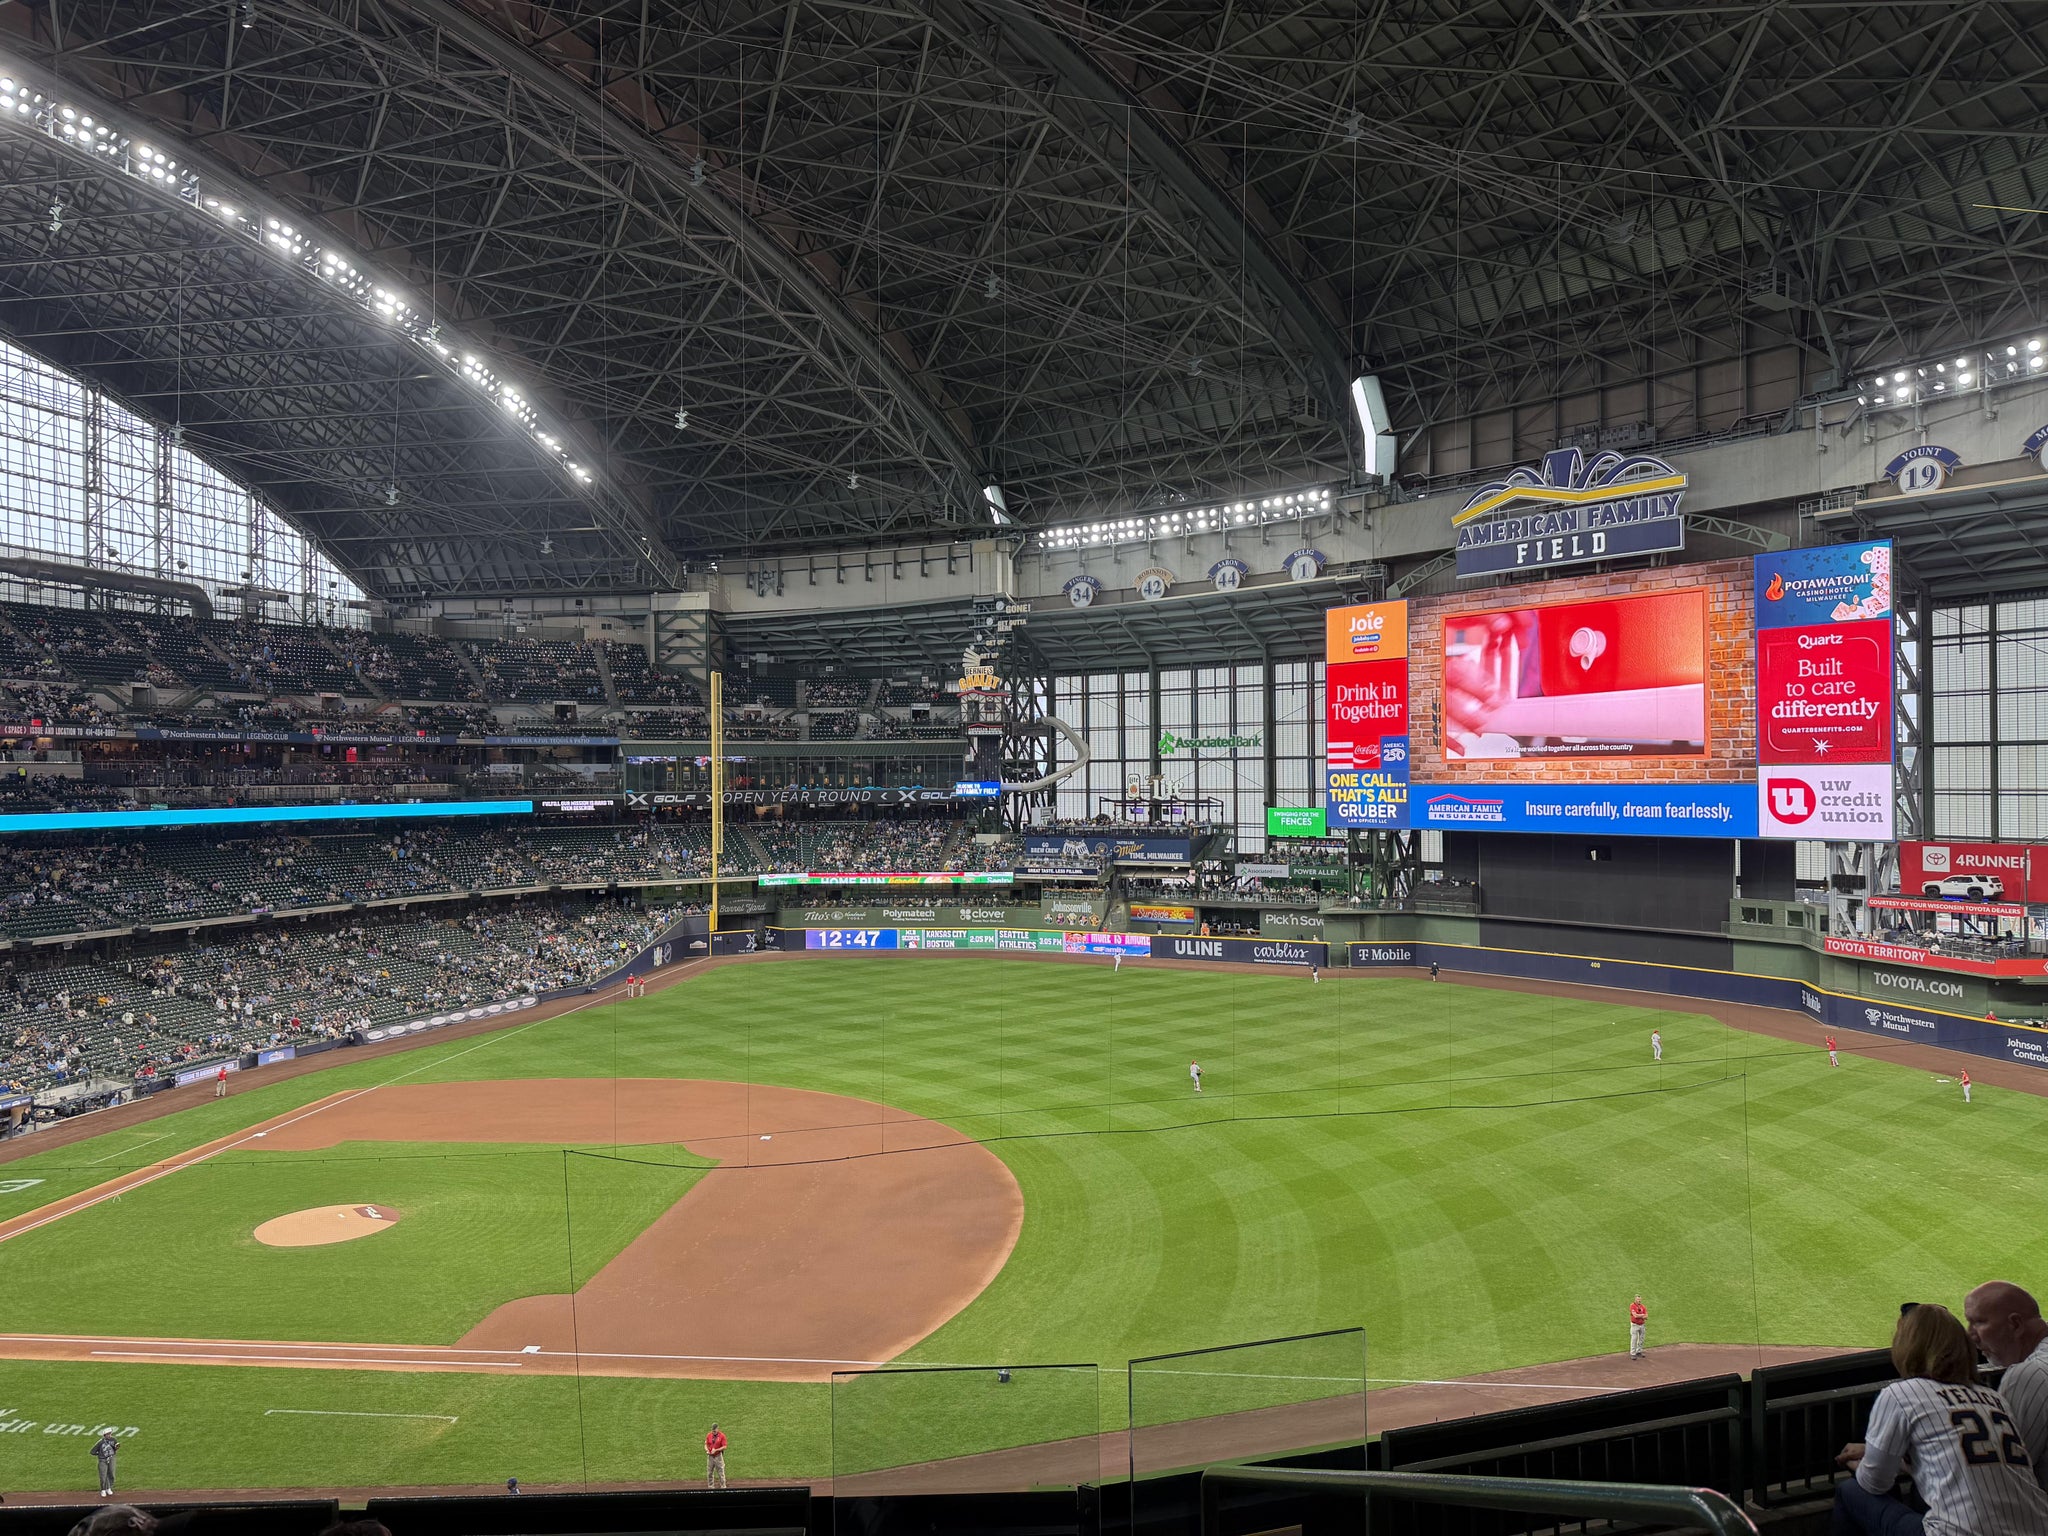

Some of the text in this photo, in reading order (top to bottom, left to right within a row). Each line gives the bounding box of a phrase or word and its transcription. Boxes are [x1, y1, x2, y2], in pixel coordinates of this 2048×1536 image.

[1901, 447, 1942, 462] YOUNT
[1905, 464, 1938, 491] 19
[1457, 490, 1687, 549] AMERICAN FAMILY
[1293, 548, 1315, 559] SELIG
[1516, 532, 1606, 564] FIELD
[1217, 560, 1239, 570] AARON
[1300, 562, 1309, 579] 1
[1138, 567, 1169, 580] ROBINSON
[1218, 571, 1237, 587] 44
[1068, 576, 1096, 586] FINGERS
[1143, 580, 1162, 596] 42
[1784, 574, 1870, 591] POTAWATOMI
[1072, 587, 1091, 602] 34
[1796, 586, 1854, 598] CASINO HOTEL
[1806, 594, 1847, 602] MILWAUKEE
[1005, 604, 1031, 614] GONE!
[1348, 610, 1384, 633] Joie
[1798, 634, 1844, 650] Quartz
[965, 667, 994, 676] BERNIE'S
[1798, 658, 1844, 678] Built
[959, 674, 1000, 690] CHALET
[1786, 680, 1856, 697] to care
[1336, 681, 1397, 703] Drink in
[1332, 700, 1403, 723] Together
[1771, 697, 1880, 720] differently
[169, 730, 289, 741] Northwestern Mutual LEGENDS CLUB
[1781, 725, 1863, 734] QUARTZBENEFITS.COM
[323, 734, 369, 742] Northwestern
[398, 735, 425, 743] LEGENDS
[1175, 735, 1262, 748] Associated Bank
[1383, 748, 1406, 762] 250
[1548, 745, 1572, 753] together
[1610, 744, 1633, 752] country
[1329, 773, 1406, 788] ONE CALL...
[1820, 780, 1852, 791] uw
[627, 793, 649, 806] X
[653, 794, 697, 803] GOLF
[721, 792, 765, 803] OPEN
[770, 791, 810, 803] YEAR
[818, 790, 872, 802] ROUND
[898, 790, 918, 801] X
[920, 791, 957, 800] GOLF
[1329, 788, 1408, 803] THAT'S ALL!
[1820, 792, 1882, 807] credit
[1338, 804, 1397, 818] GRUBER
[1428, 804, 1502, 813] AMERICAN FAMILY
[1525, 801, 1733, 822] Insure carefully, dream fearlessly.
[1820, 808, 1884, 823] union
[1281, 817, 1313, 826] FENCES
[1114, 844, 1145, 859] Miller
[1129, 853, 1147, 861] TIME,
[820, 876, 857, 884] HOME
[882, 909, 935, 919] Polymatech
[971, 908, 1005, 919] clover
[1050, 901, 1092, 914] Johnsonville
[1137, 908, 1169, 920] Surfside
[1869, 899, 1900, 907] COURTESY
[1909, 901, 1927, 909] YOUR
[1927, 903, 1964, 911] WISCONSIN
[1965, 905, 1991, 913] TOYOTA
[1991, 906, 2021, 915] DEALERS
[804, 911, 831, 921] Tito's
[818, 930, 881, 947] 12:47
[926, 930, 967, 938] KANSAS CITY
[969, 935, 983, 943] 2:05
[999, 930, 1029, 940] SEATTLE
[926, 939, 955, 948] BOSTON
[999, 940, 1037, 950] ATHLETICS
[1053, 938, 1063, 946] PM
[1174, 940, 1223, 957] ULINE
[1254, 942, 1309, 959] carbliss
[1371, 949, 1411, 961] Mobile
[1826, 939, 1926, 962] TOYOTA TERRITORY
[1873, 972, 1964, 998] TOYOTA.COM
[1882, 1011, 1936, 1030] Northwestern
[1882, 1021, 1910, 1033] Mutual
[2006, 1038, 2043, 1052] Johnson
[2013, 1048, 2048, 1064] Controls
[43, 1422, 140, 1438] union
[1951, 1409, 2029, 1466] 22
